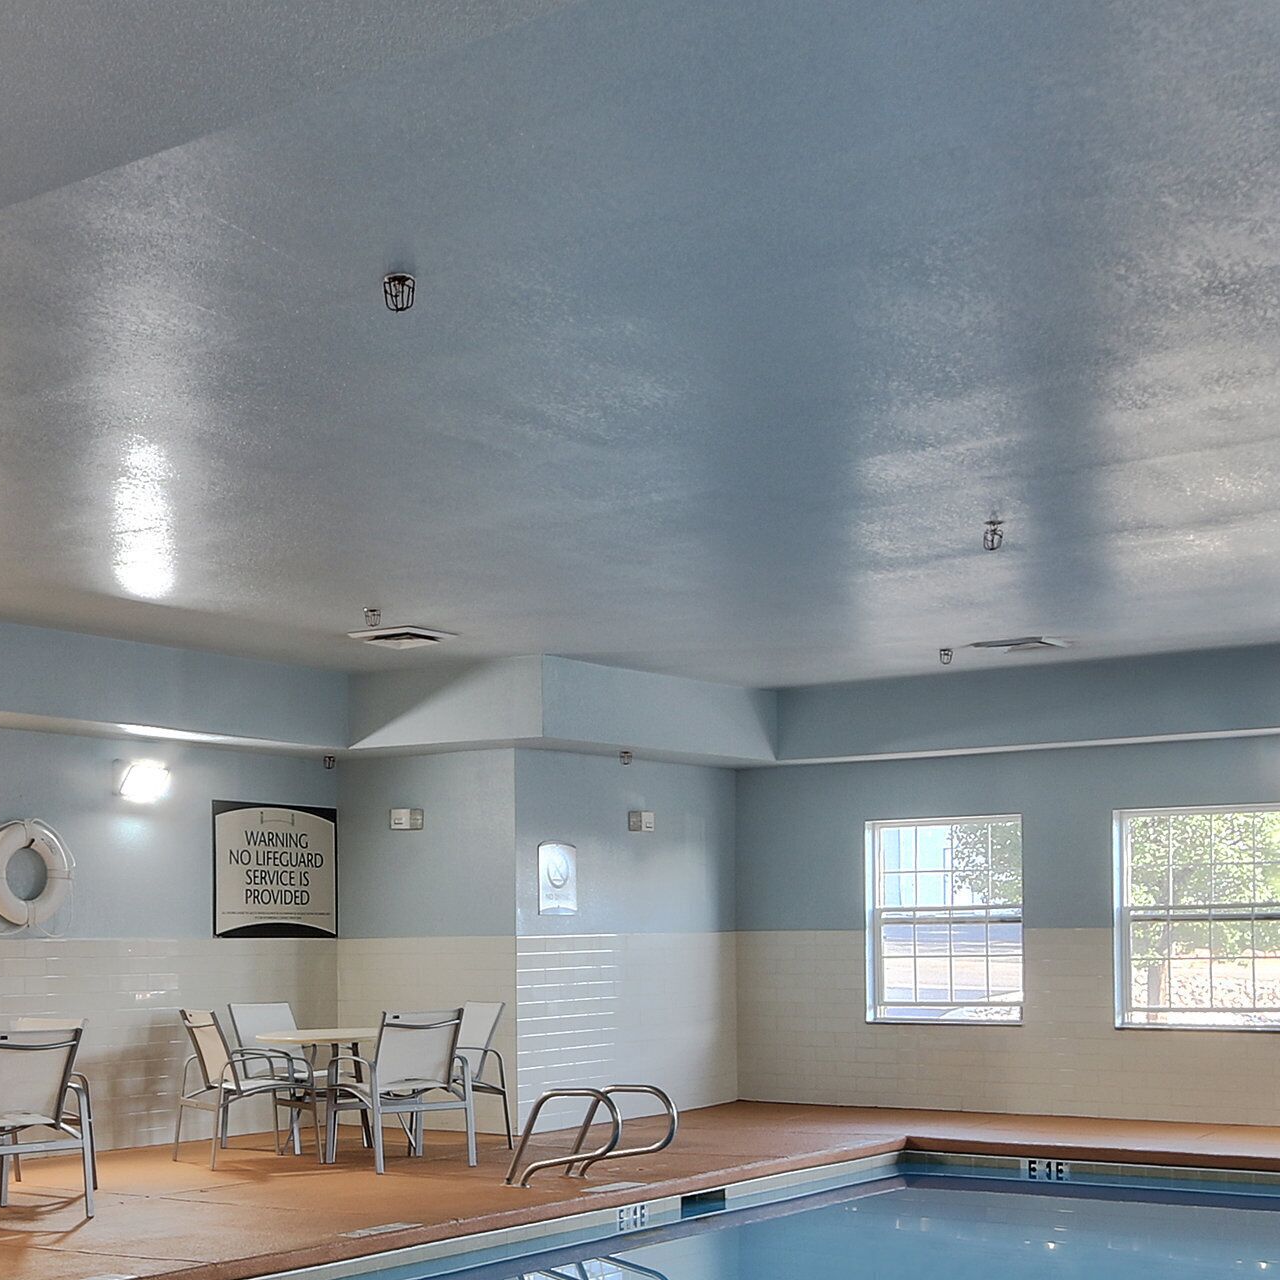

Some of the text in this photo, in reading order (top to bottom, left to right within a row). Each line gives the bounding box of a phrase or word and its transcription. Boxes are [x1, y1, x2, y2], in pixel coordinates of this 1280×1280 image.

[245, 830, 308, 849] WARNING
[229, 849, 324, 868] NO LIFEGUARD
[245, 869, 310, 887] SERVICE IS
[245, 889, 310, 905] PROVIDED
